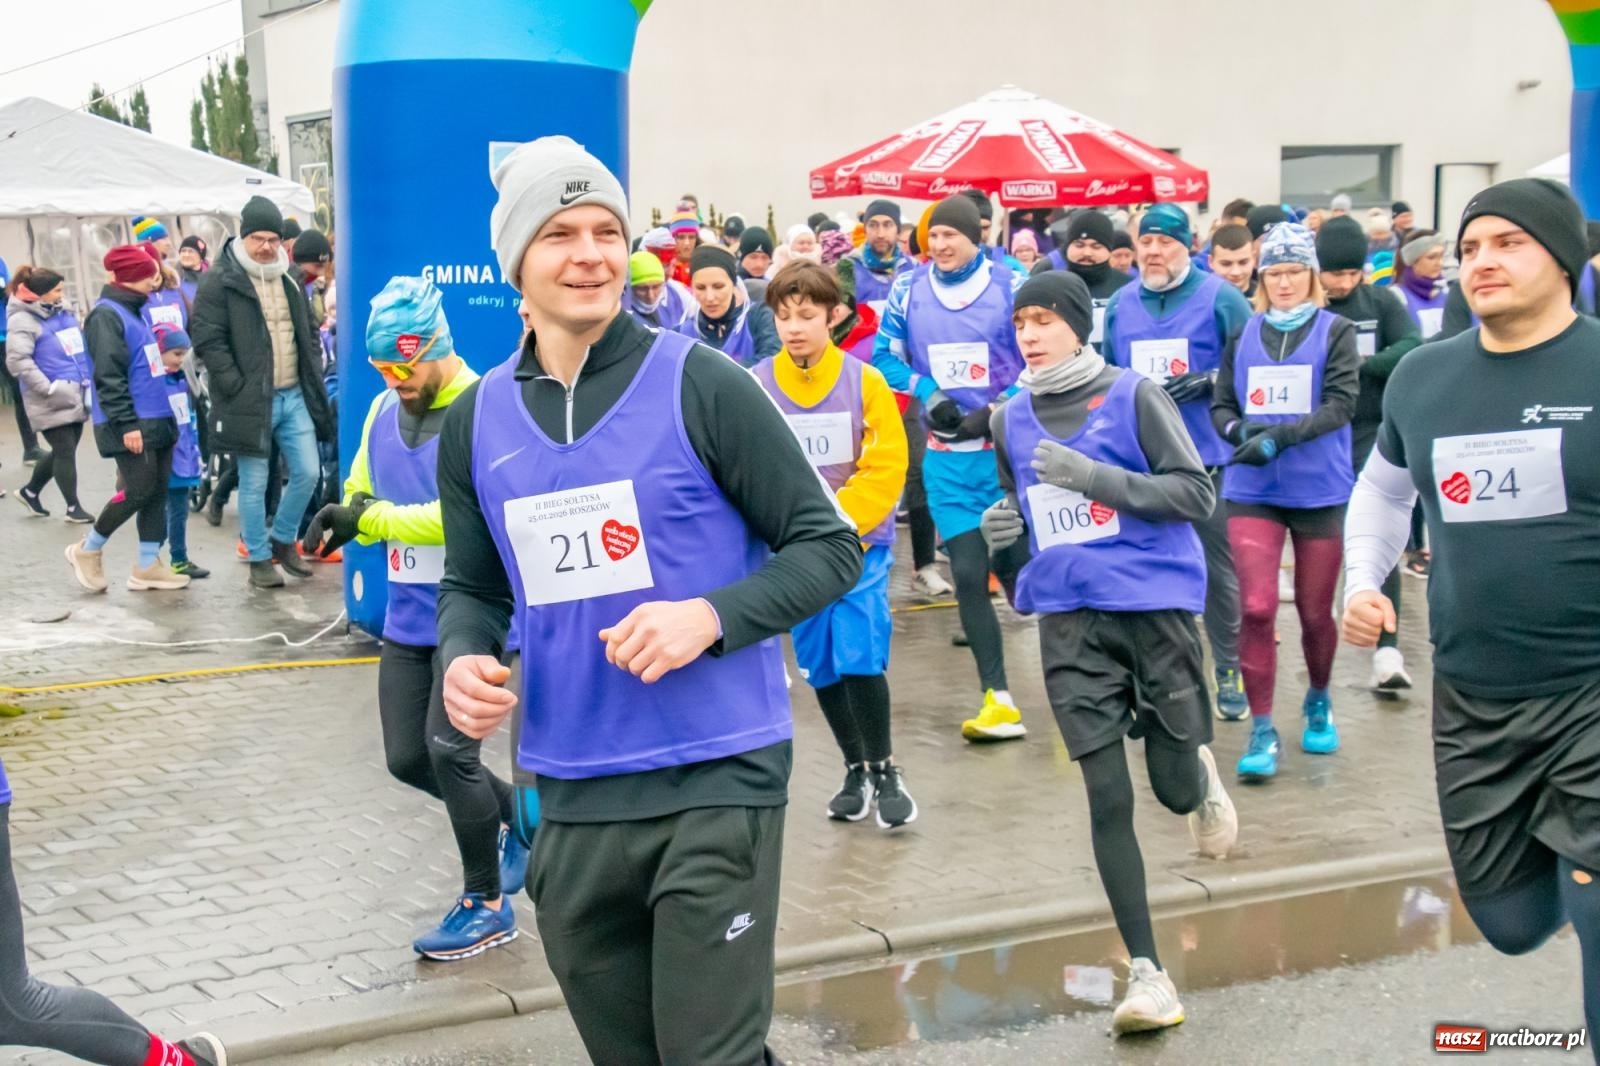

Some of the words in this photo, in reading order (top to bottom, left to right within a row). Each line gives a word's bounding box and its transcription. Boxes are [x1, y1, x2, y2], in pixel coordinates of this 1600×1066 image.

[1022, 121, 1076, 169] WARKA
[565, 181, 591, 194] NIKE
[1006, 184, 1052, 196] WARKA
[421, 264, 495, 284] GMINA
[468, 295, 505, 308] odkryj
[946, 360, 969, 378] 37
[1149, 356, 1168, 374] 13
[1268, 386, 1289, 404] 14
[805, 435, 829, 456] 10
[1474, 467, 1520, 501] 24
[535, 502, 541, 510] II
[543, 499, 563, 510] BIEG
[563, 493, 601, 506] SOŁTYSA
[528, 510, 568, 523] 25.01.2026
[569, 501, 611, 516] ROSZKÓW
[1047, 503, 1091, 534] 106
[404, 546, 416, 570] 6
[550, 530, 600, 574] 21
